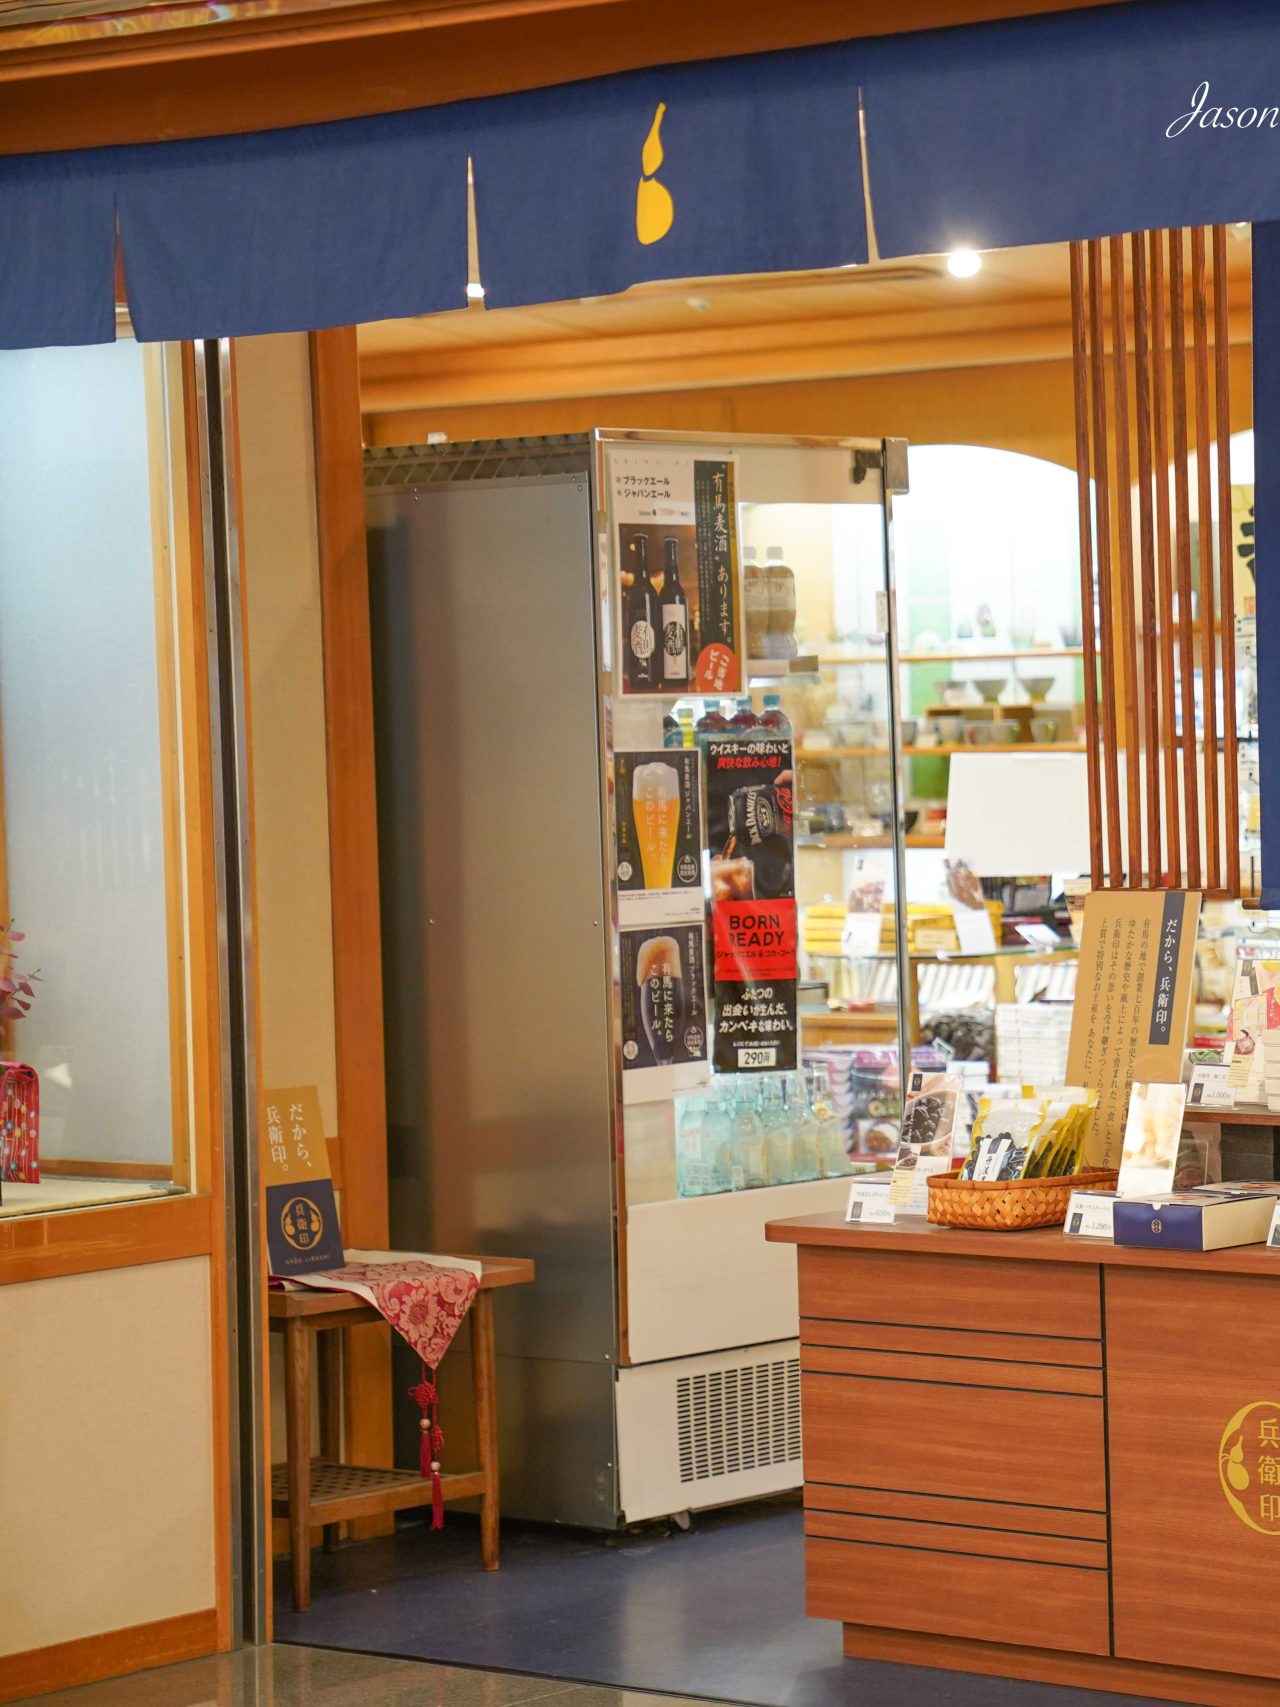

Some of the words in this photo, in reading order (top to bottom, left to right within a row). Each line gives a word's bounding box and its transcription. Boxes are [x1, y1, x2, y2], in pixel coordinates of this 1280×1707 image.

[623, 475, 671, 486] ブラックエール
[624, 487, 671, 498] ジャパンエール
[729, 914, 780, 930] BORN
[729, 931, 785, 947] READY
[741, 988, 774, 1000] ふたつの
[1155, 919, 1178, 1032] だから、兵衛印。
[650, 965, 662, 1036] このビール。
[661, 963, 674, 1043] 有馬に来たら
[266, 1106, 288, 1171] 兵衛印。
[289, 1103, 312, 1168] だから、
